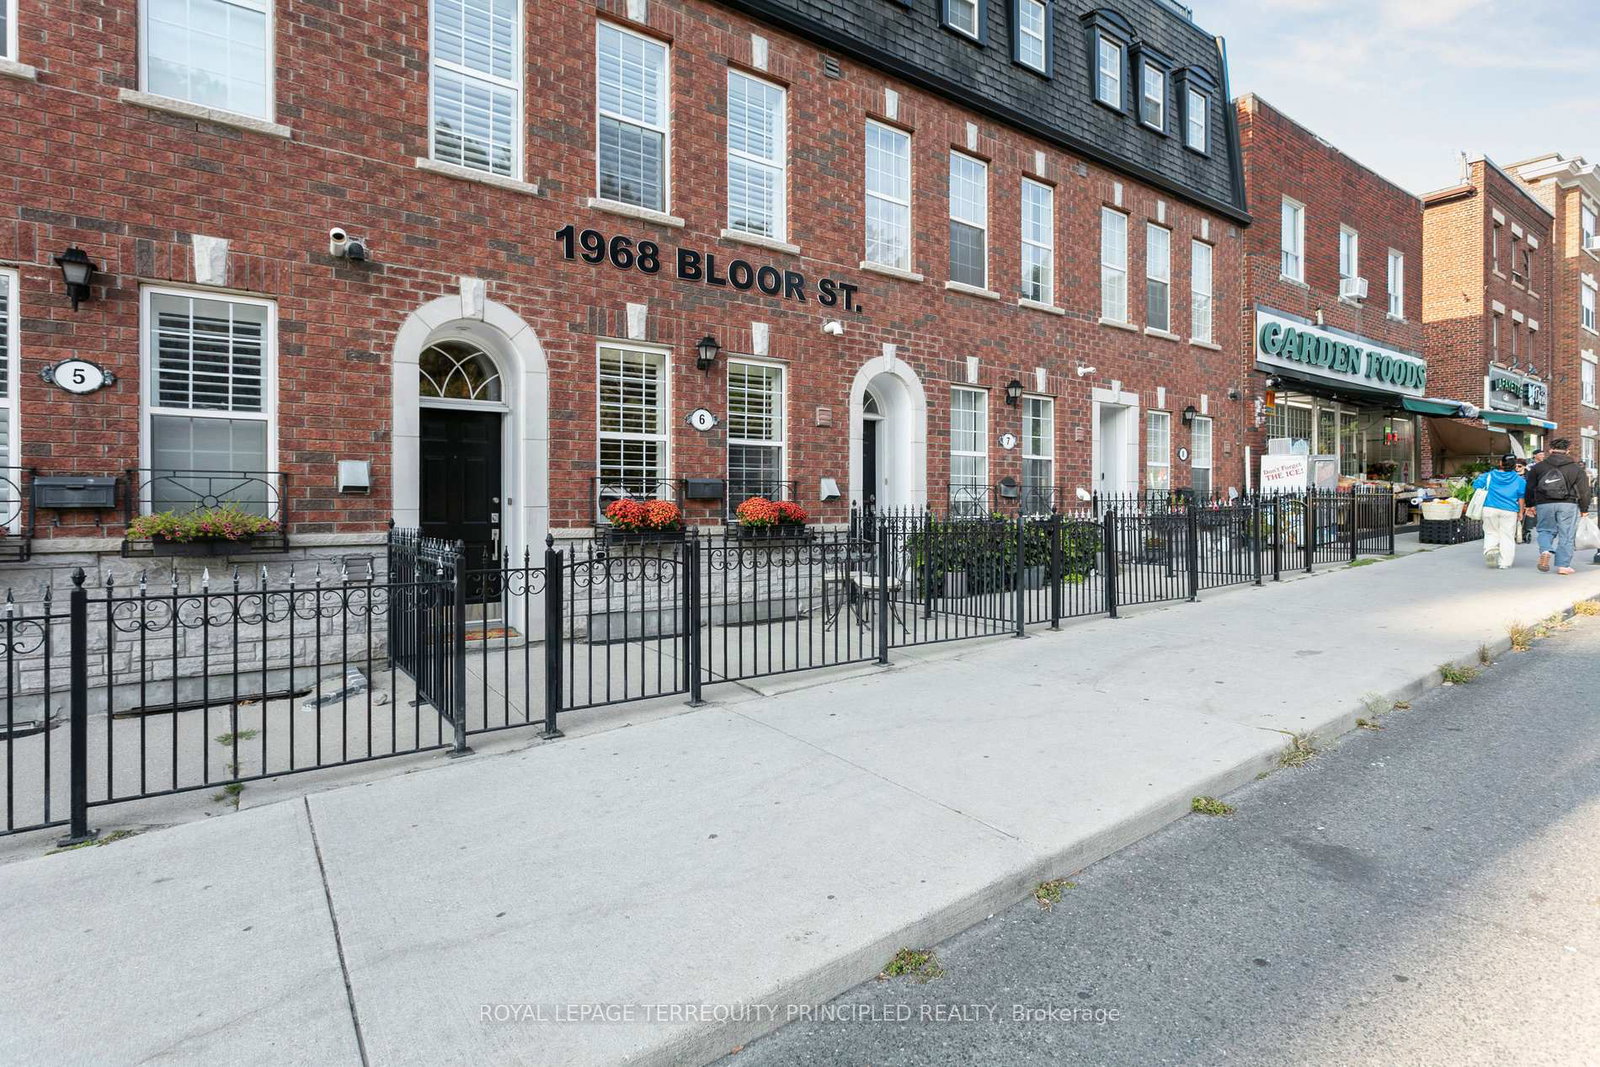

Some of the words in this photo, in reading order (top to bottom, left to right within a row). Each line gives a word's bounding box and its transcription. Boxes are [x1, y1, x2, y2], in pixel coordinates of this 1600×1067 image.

[555, 224, 661, 275] 1968
[676, 247, 806, 302] BLOOR
[817, 278, 863, 313] ST.
[1260, 321, 1363, 375] GARDEN
[1365, 351, 1427, 389] FOODS
[72, 368, 86, 385] 5
[698, 414, 706, 425] 6
[1263, 466, 1281, 476] Don't
[1281, 462, 1302, 472] Forget
[1264, 473, 1284, 481] THE
[1285, 468, 1305, 478] ICE!
